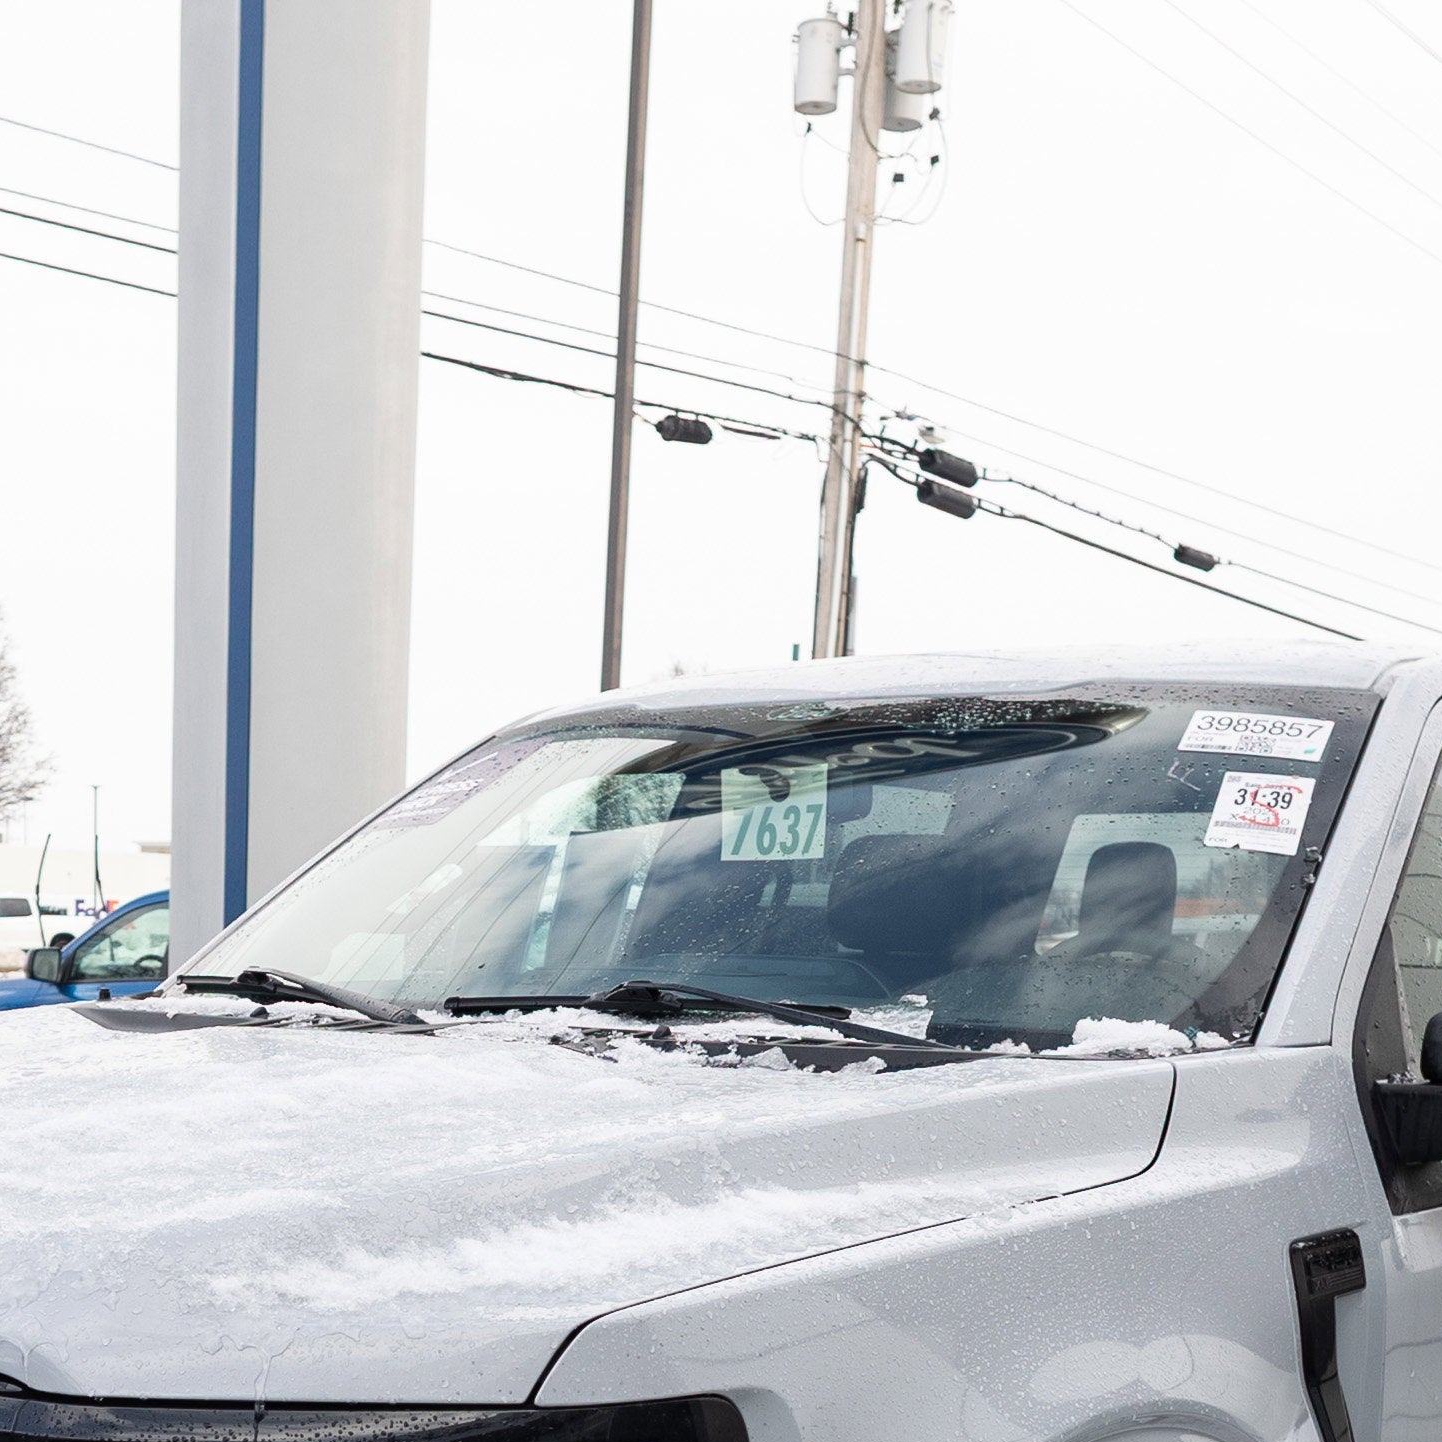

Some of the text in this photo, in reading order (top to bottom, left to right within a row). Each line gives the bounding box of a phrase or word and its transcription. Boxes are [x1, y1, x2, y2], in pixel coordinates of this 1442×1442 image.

[1196, 715, 1324, 740] 3985857
[1234, 787, 1294, 810] 31-39
[730, 803, 824, 856] 7637
